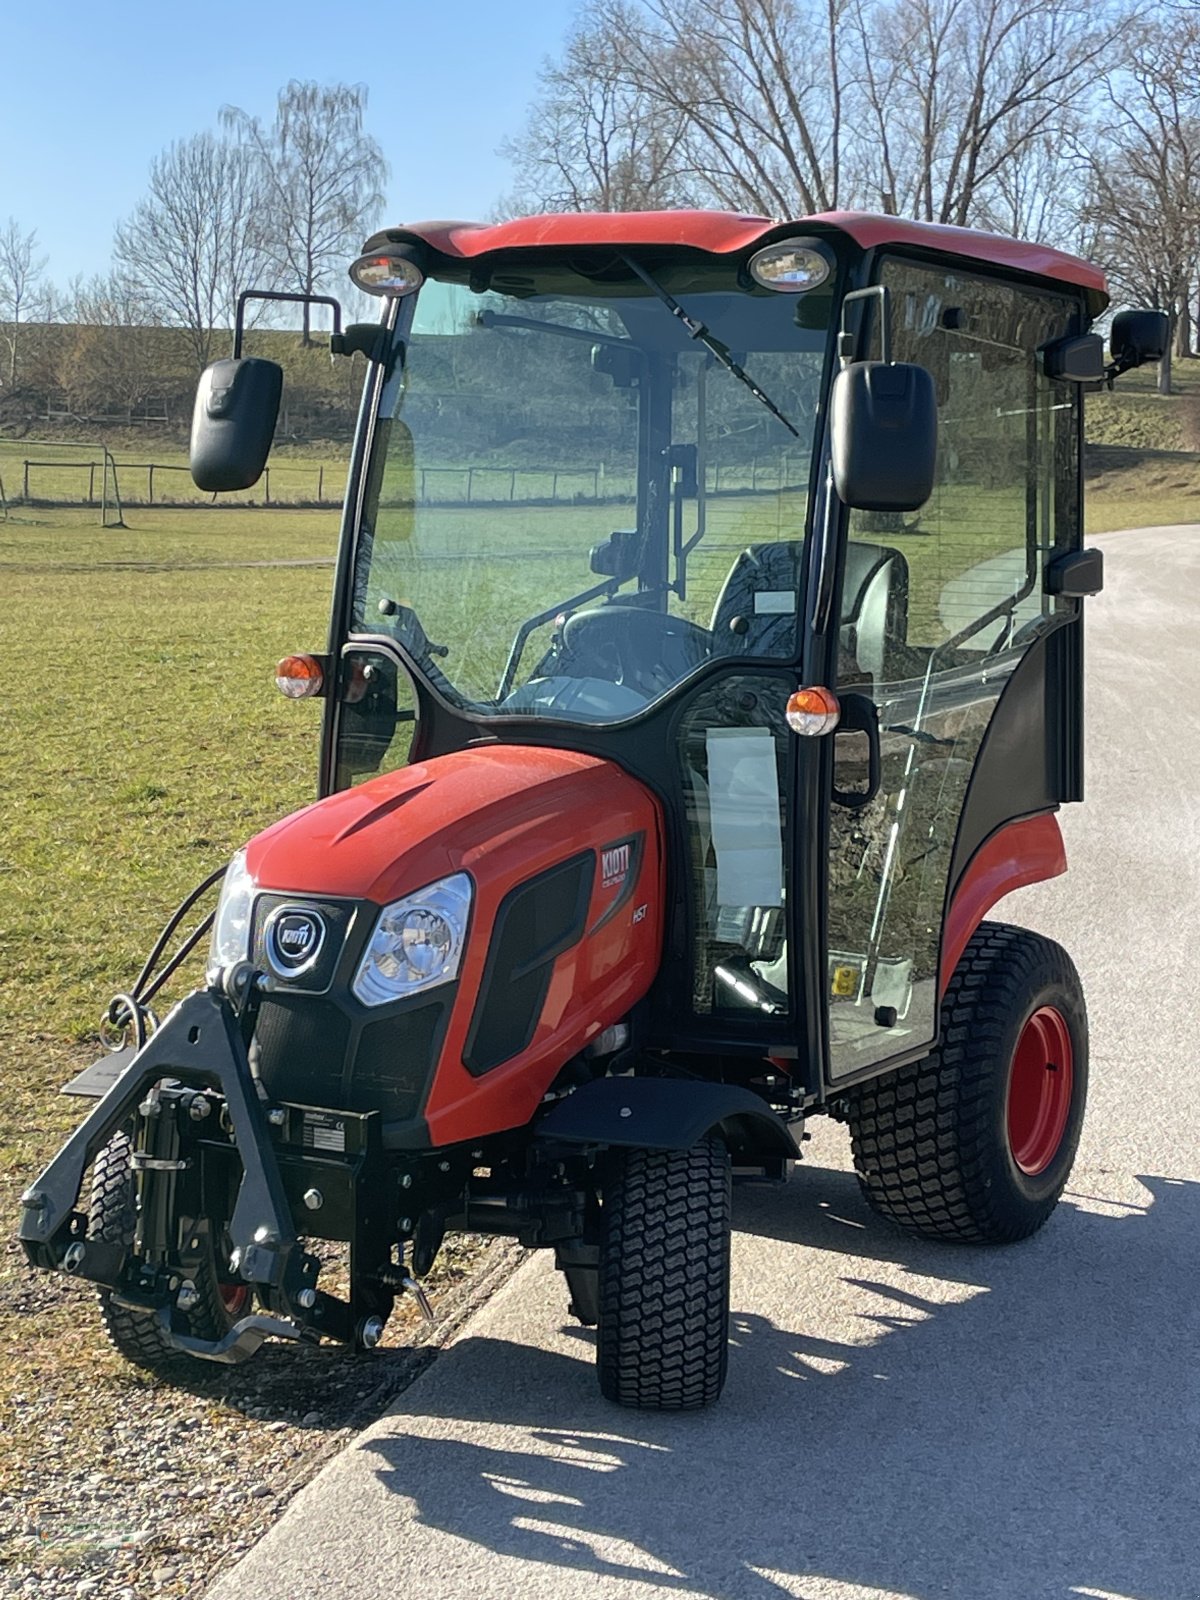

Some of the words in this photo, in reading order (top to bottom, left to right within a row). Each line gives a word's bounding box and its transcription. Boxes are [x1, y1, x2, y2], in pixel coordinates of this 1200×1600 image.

[602, 844, 630, 879] KIOTI
[633, 904, 648, 924] HST
[282, 924, 309, 945] KIOTI
